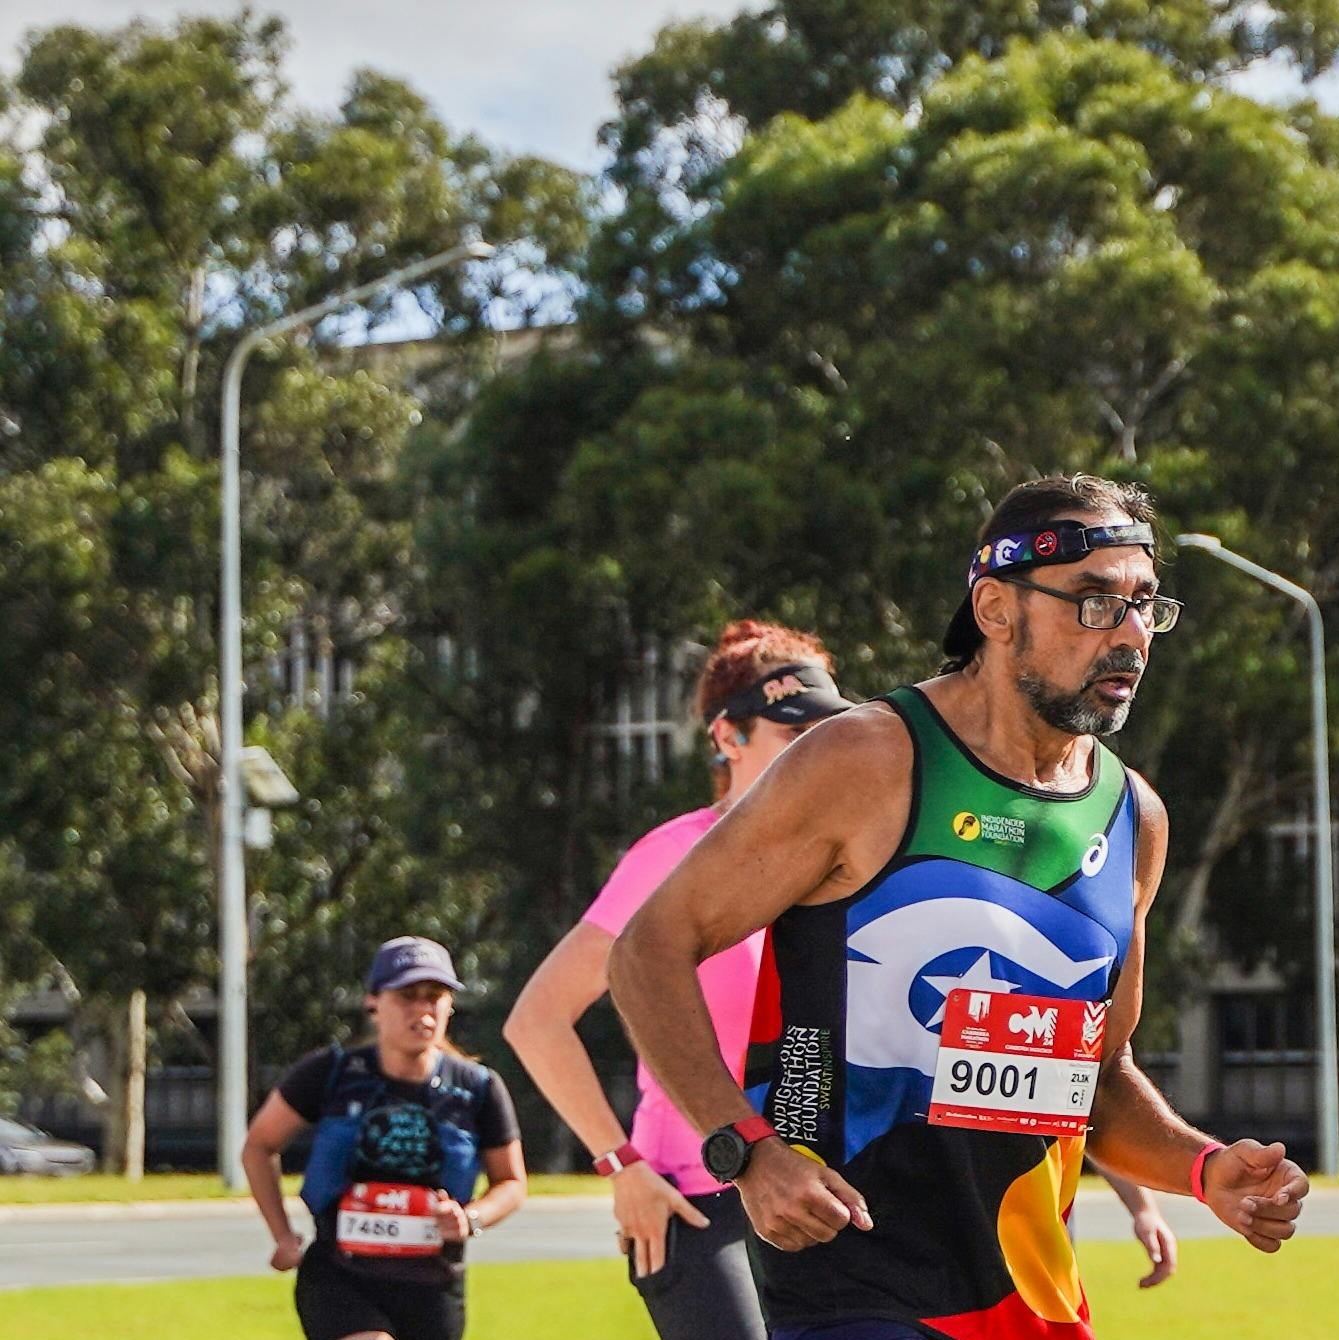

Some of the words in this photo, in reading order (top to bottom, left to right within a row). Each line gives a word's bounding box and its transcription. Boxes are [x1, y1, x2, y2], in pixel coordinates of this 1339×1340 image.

[787, 1027, 808, 1140] MARATHON
[801, 1028, 822, 1142] FOUNDATION
[950, 1059, 1038, 1100] 9001
[1071, 1091, 1079, 1104] C
